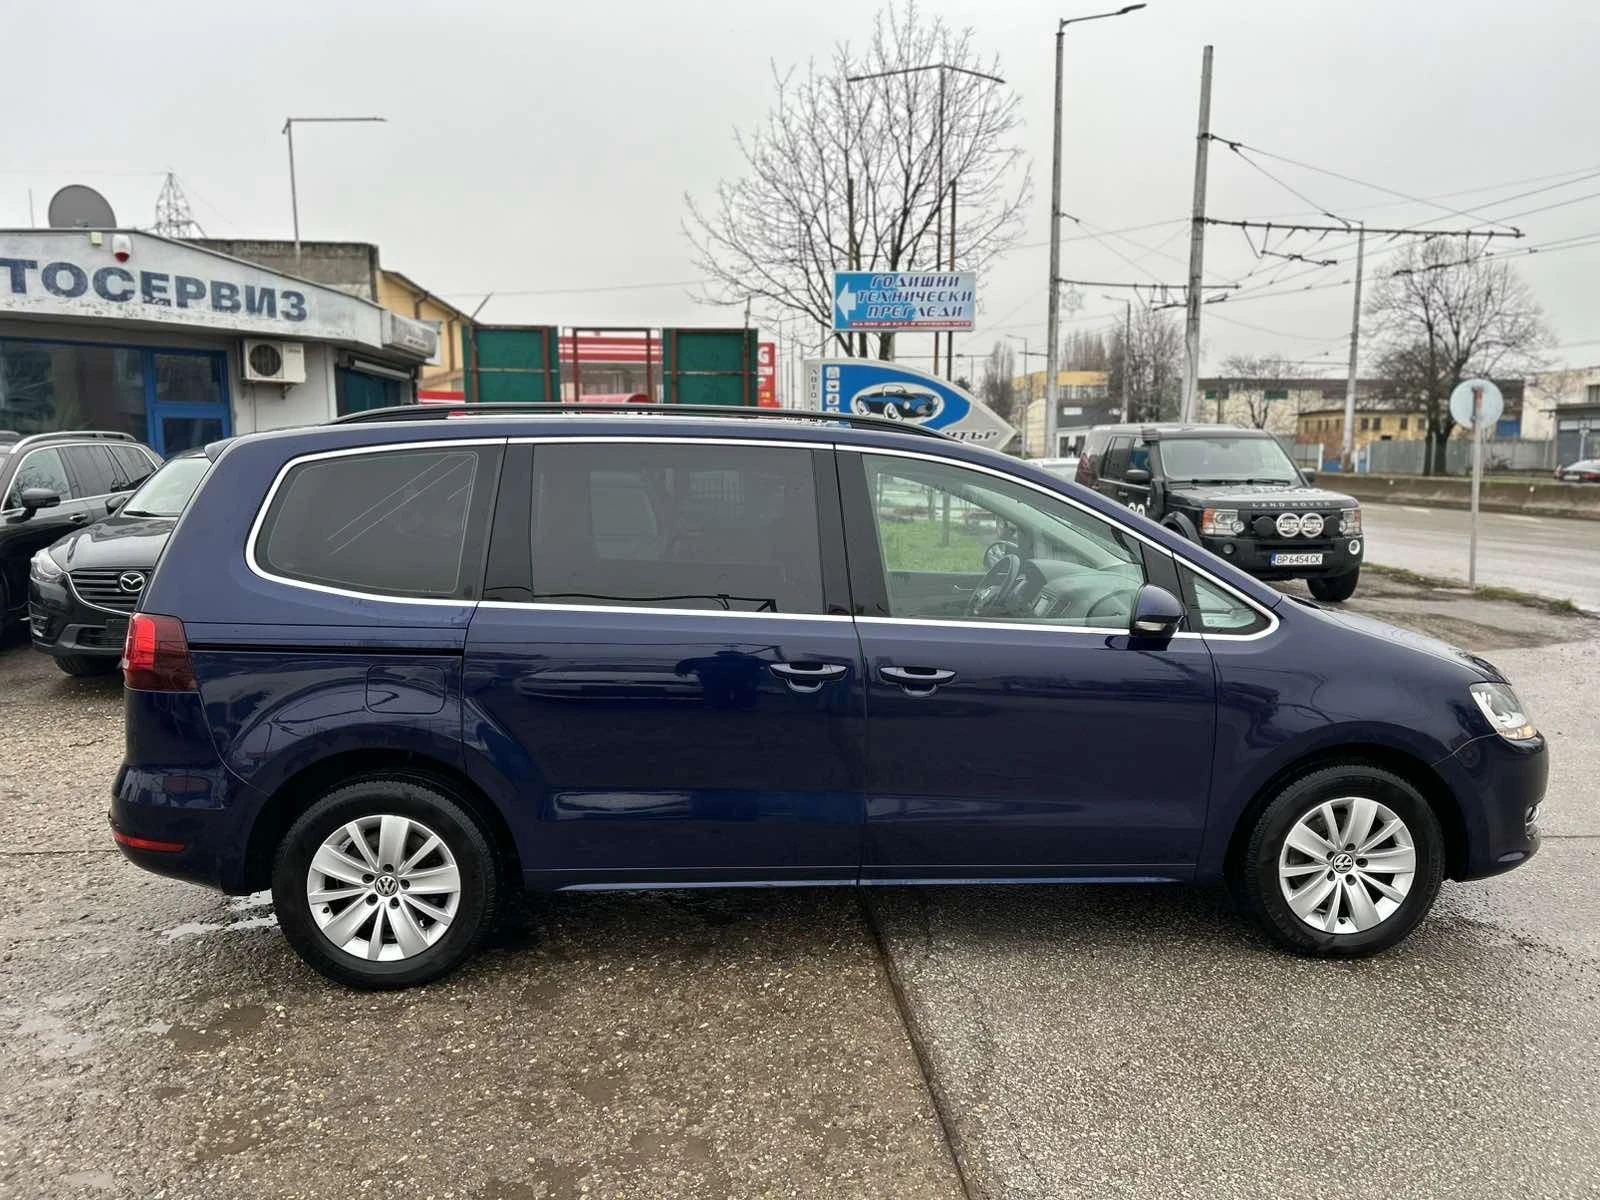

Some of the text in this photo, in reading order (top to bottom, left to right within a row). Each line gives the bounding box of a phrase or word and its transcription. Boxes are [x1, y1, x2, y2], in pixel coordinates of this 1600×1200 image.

[870, 274, 960, 288] ГОДИШНИ
[0, 257, 307, 322] ТОСЕРВИЗ
[857, 290, 973, 303] ТЕХНИЧЕСКИ
[867, 304, 963, 317] ПРЕГЛЕДИ
[1289, 554, 1309, 564] 6454
